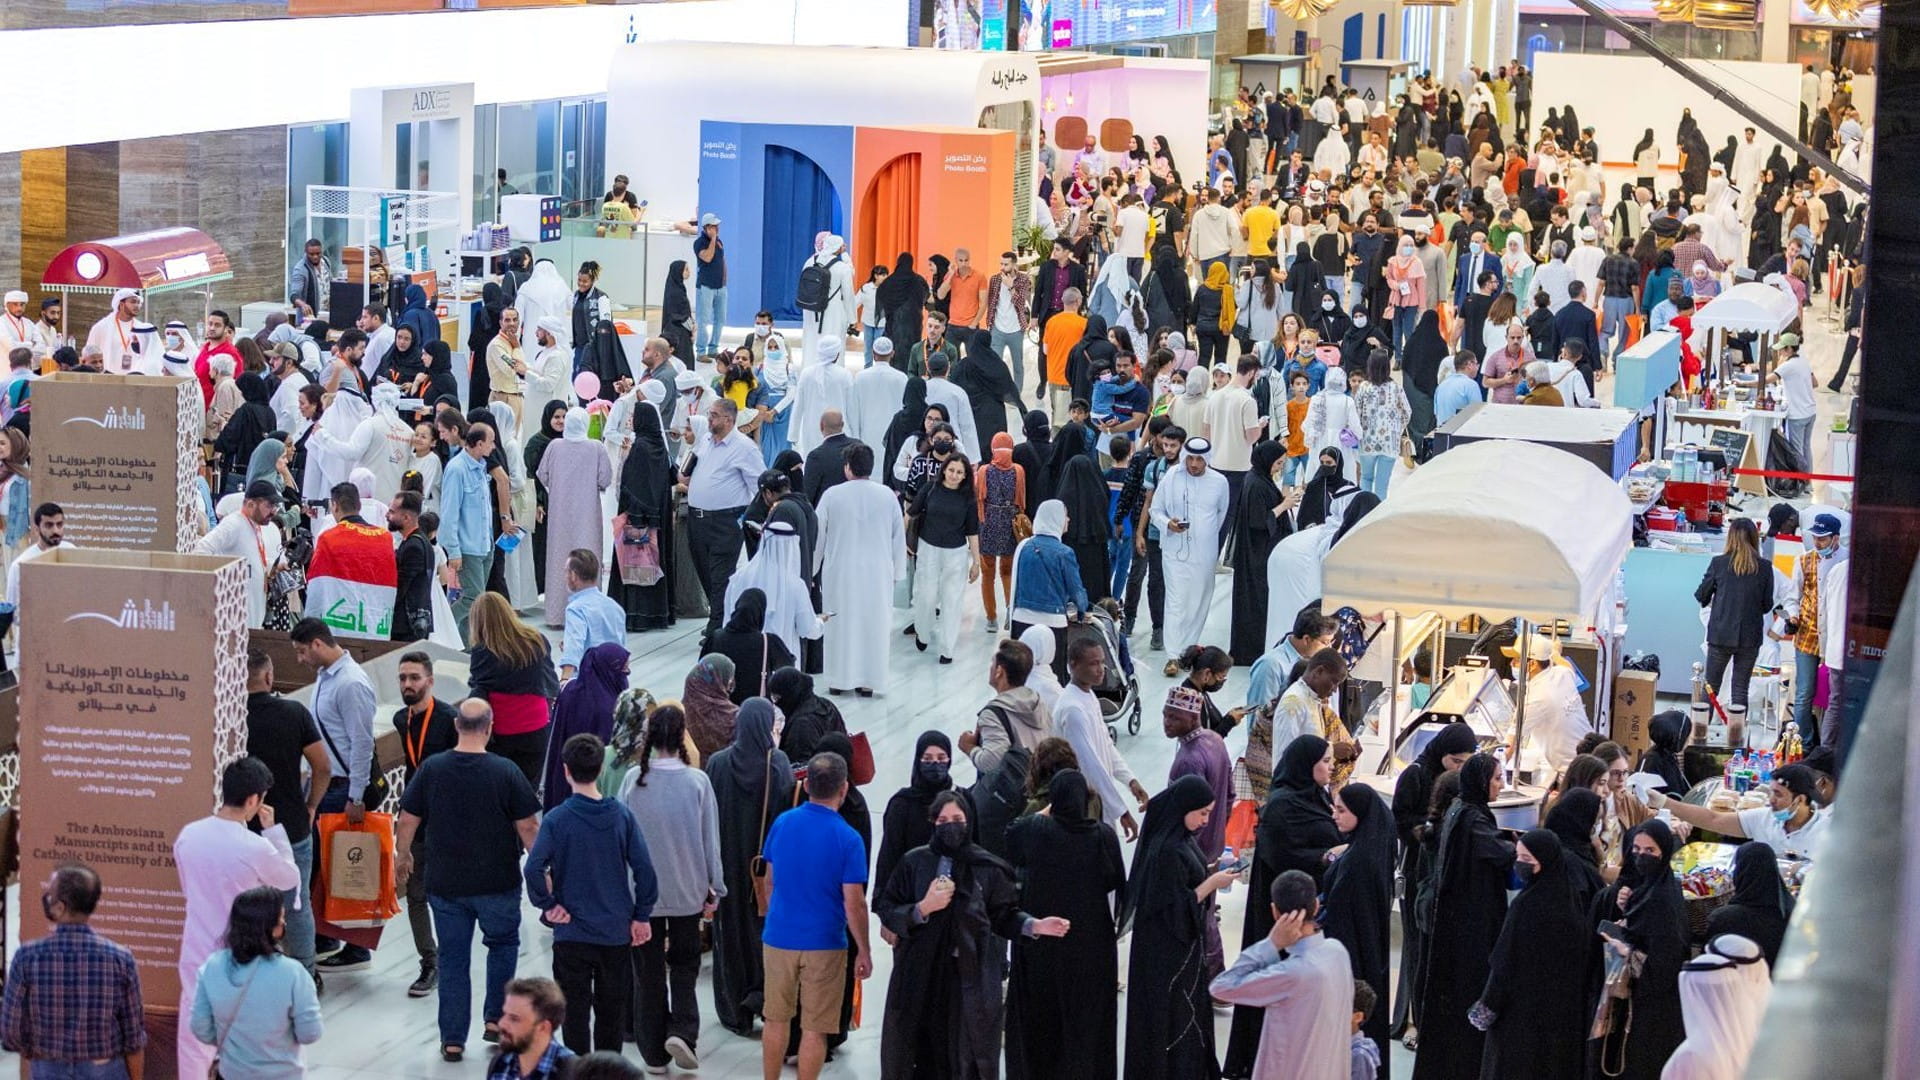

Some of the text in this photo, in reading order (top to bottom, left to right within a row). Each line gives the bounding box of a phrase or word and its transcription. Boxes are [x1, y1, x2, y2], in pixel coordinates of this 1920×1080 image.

[411, 90, 436, 112] ADX
[703, 151, 737, 160] Photo Booth
[944, 163, 987, 173] Photo Booth
[108, 456, 156, 469] مخطوطات
[72, 480, 132, 492] في ميلانو
[125, 667, 190, 682] مخطوطات
[46, 679, 187, 701] والجامعة الكاثوليكية
[78, 698, 157, 714] في ميلانو
[67, 822, 165, 839] The Ambrosiana
[54, 836, 130, 853] Manuscripts
[132, 842, 154, 853] and
[86, 851, 147, 868] University
[150, 856, 163, 867] of
